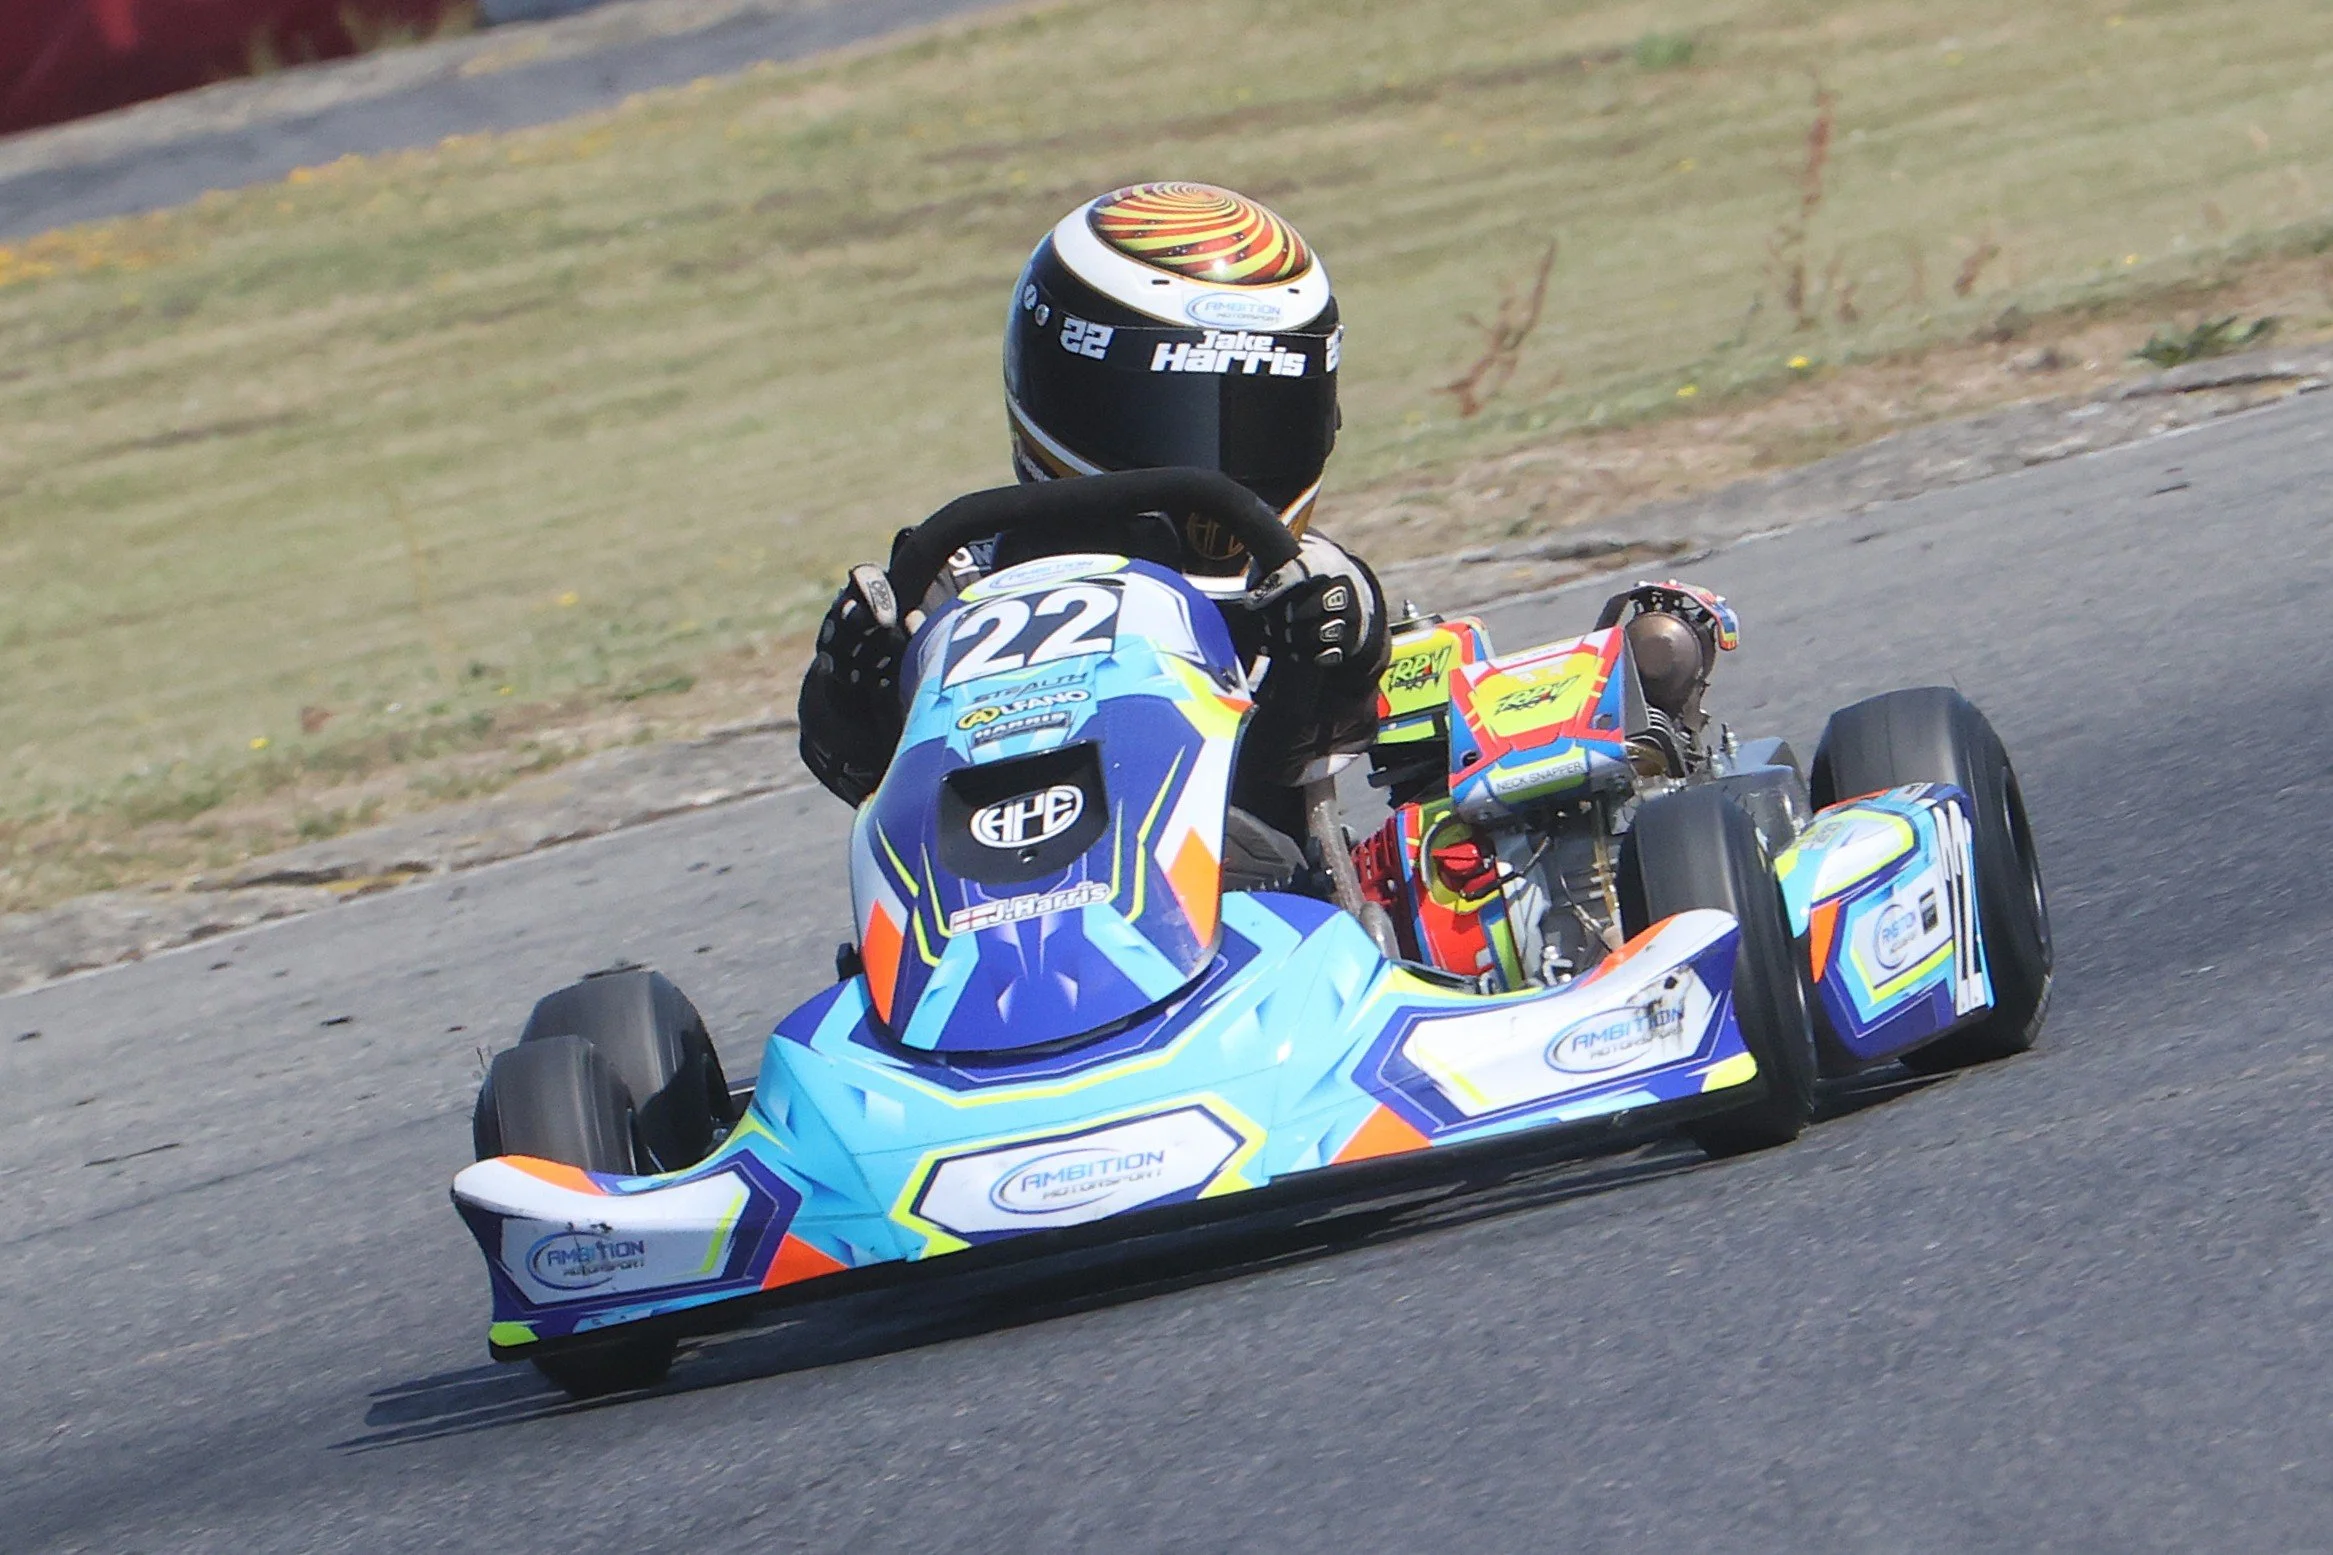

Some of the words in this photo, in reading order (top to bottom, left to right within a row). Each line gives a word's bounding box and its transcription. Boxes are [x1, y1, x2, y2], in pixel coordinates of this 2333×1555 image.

[1059, 317, 1115, 360] 22
[1196, 330, 1275, 352] Jake
[1151, 343, 1307, 377] Harris
[943, 586, 1118, 690] 22
[1529, 761, 1583, 784] SNAPPER
[1021, 1150, 1166, 1191] AMBITION
